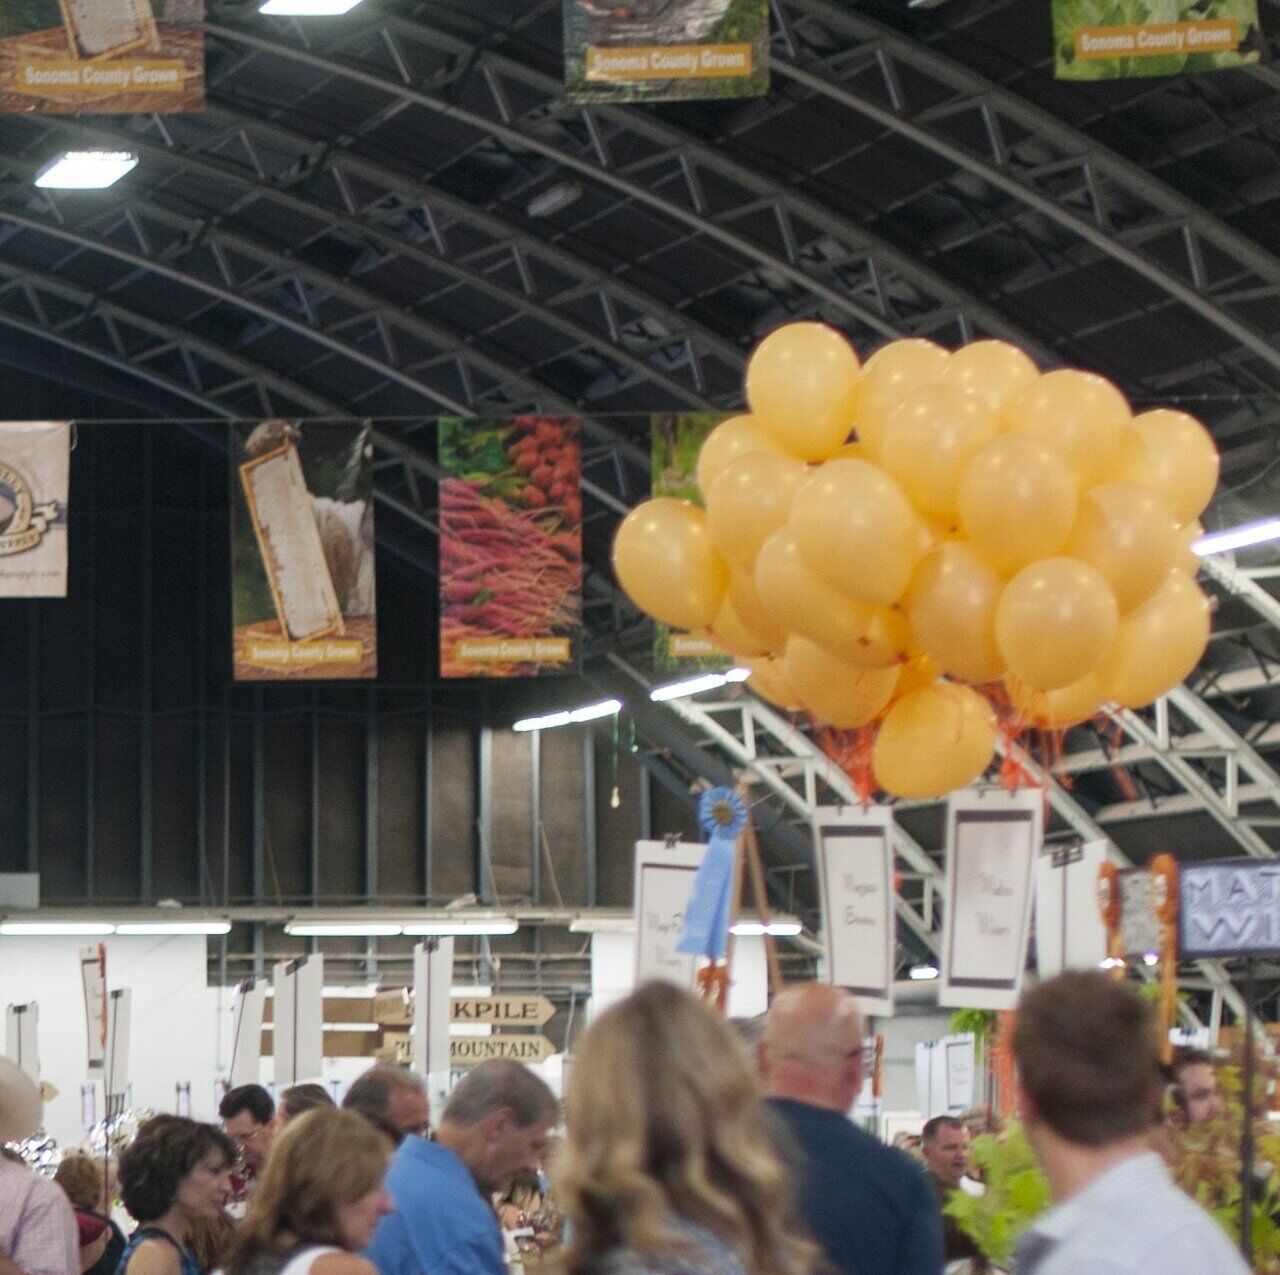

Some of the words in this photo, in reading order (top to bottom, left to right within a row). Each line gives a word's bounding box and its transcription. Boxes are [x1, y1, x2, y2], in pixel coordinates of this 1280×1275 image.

[1080, 33, 1134, 52] Sonoma
[1136, 30, 1184, 54] County
[1187, 27, 1231, 45] Grown
[593, 52, 648, 72] Sonoma
[650, 51, 699, 74] County
[701, 51, 745, 68] Grown
[25, 66, 80, 84] Sonoma
[83, 66, 131, 88] County
[133, 65, 178, 84] Grown
